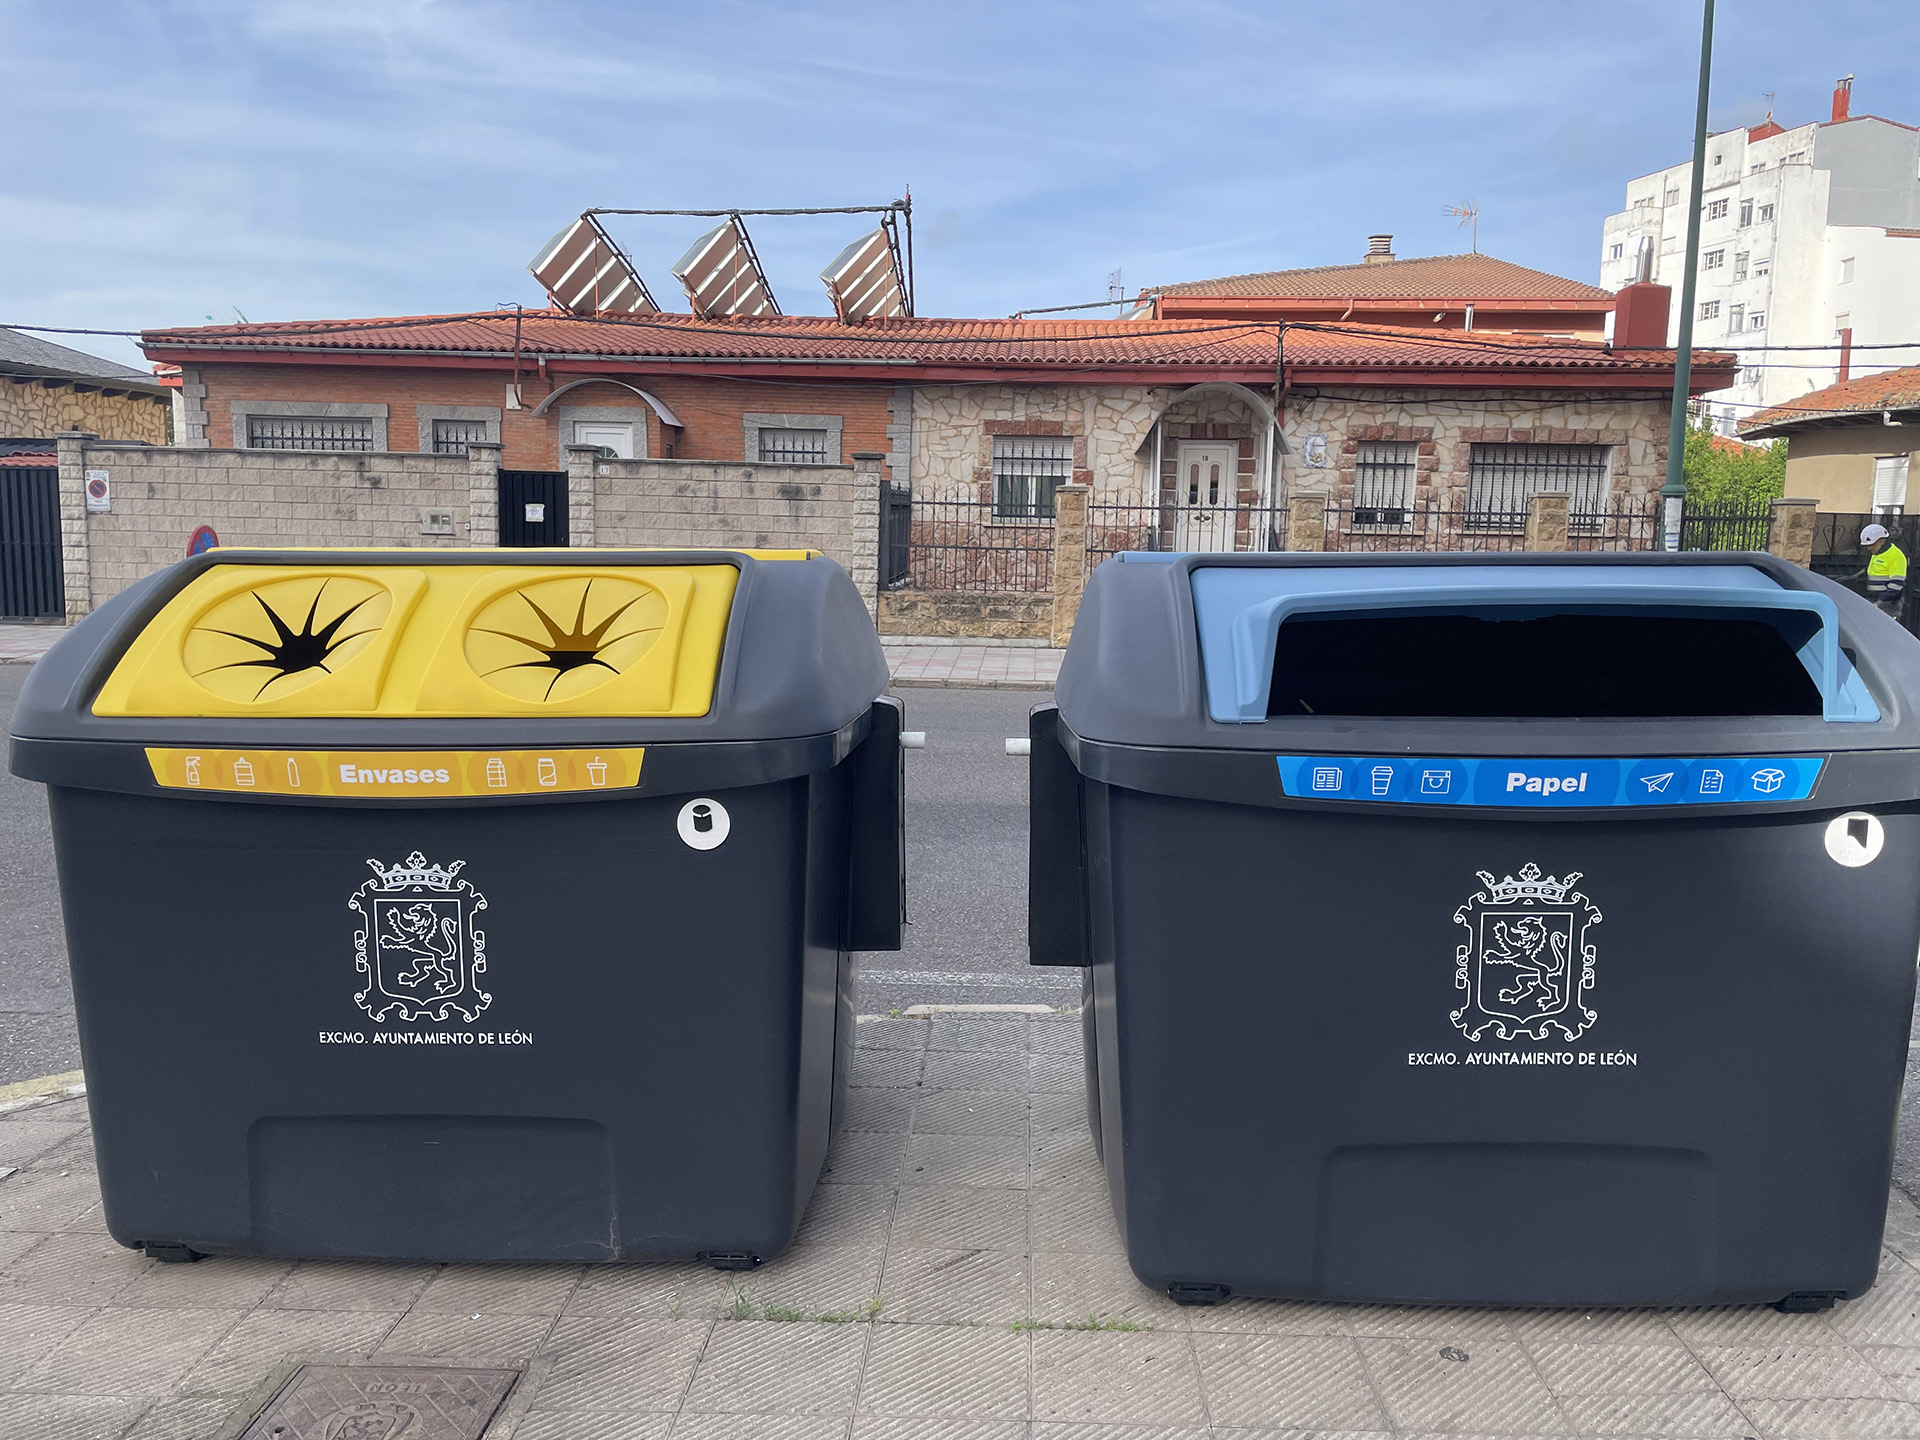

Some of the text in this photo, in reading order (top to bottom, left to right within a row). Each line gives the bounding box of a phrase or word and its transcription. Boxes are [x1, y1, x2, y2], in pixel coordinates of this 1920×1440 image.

[340, 764, 450, 783] Envases
[1506, 772, 1588, 796] Papel
[319, 1029, 533, 1045] EXCMO. AYUNTAMIENTO DE LEÓN
[1408, 1049, 1638, 1066] EXCMO. AYUNTAMIENTO DE LEÓN
